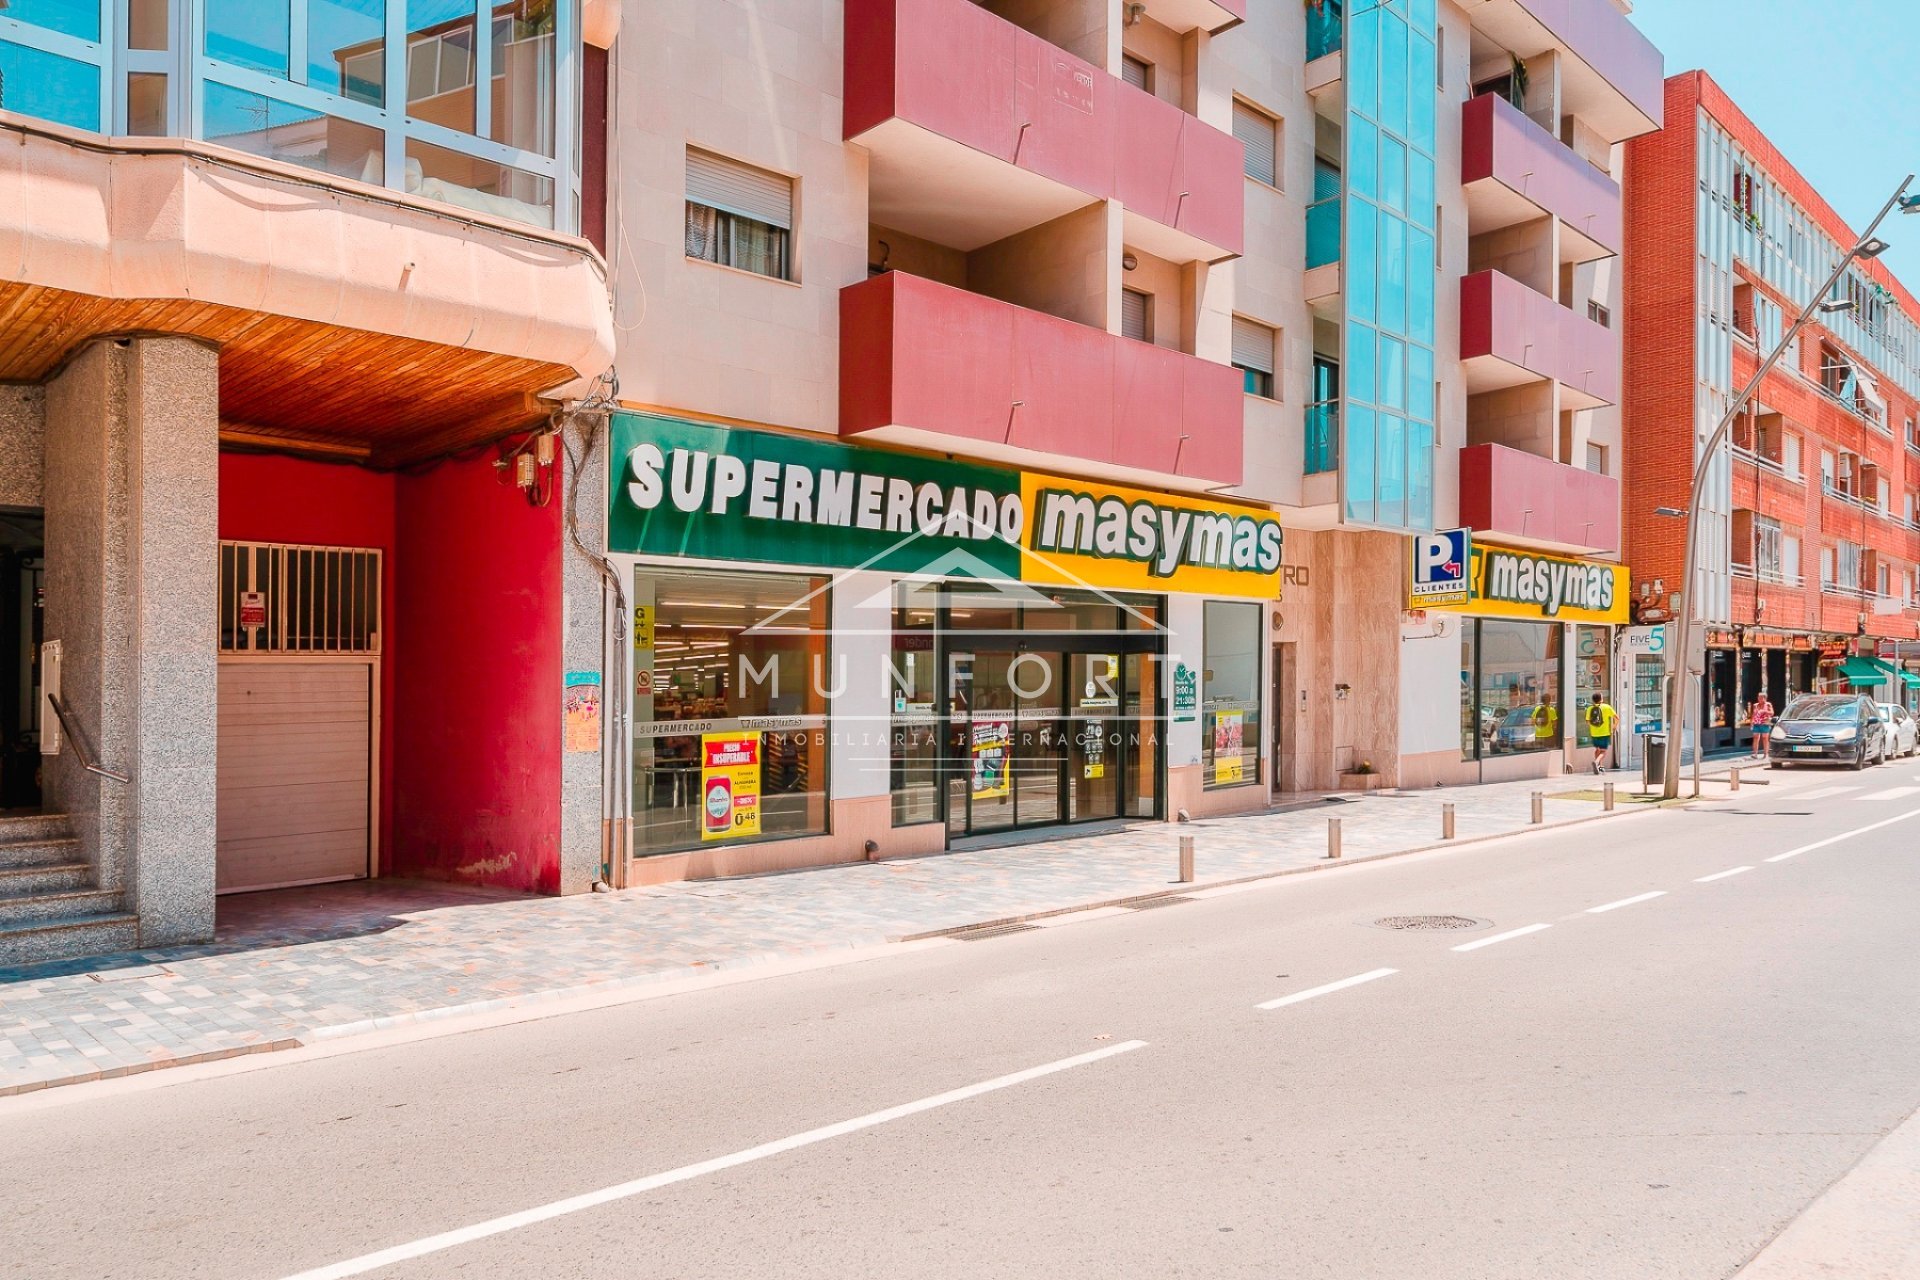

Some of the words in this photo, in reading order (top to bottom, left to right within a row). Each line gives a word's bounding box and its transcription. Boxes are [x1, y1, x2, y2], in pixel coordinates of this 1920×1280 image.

[627, 442, 1024, 544] SUPERMERCADO
[1038, 490, 1282, 577] masymas
[1418, 534, 1453, 583] P
[1414, 582, 1464, 593] CLIENTES
[1491, 552, 1615, 615] masymas
[1630, 634, 1650, 644] FIVE
[1649, 627, 1665, 651] 5
[639, 721, 713, 734] SUPERMERCADO
[750, 717, 802, 730] masymas
